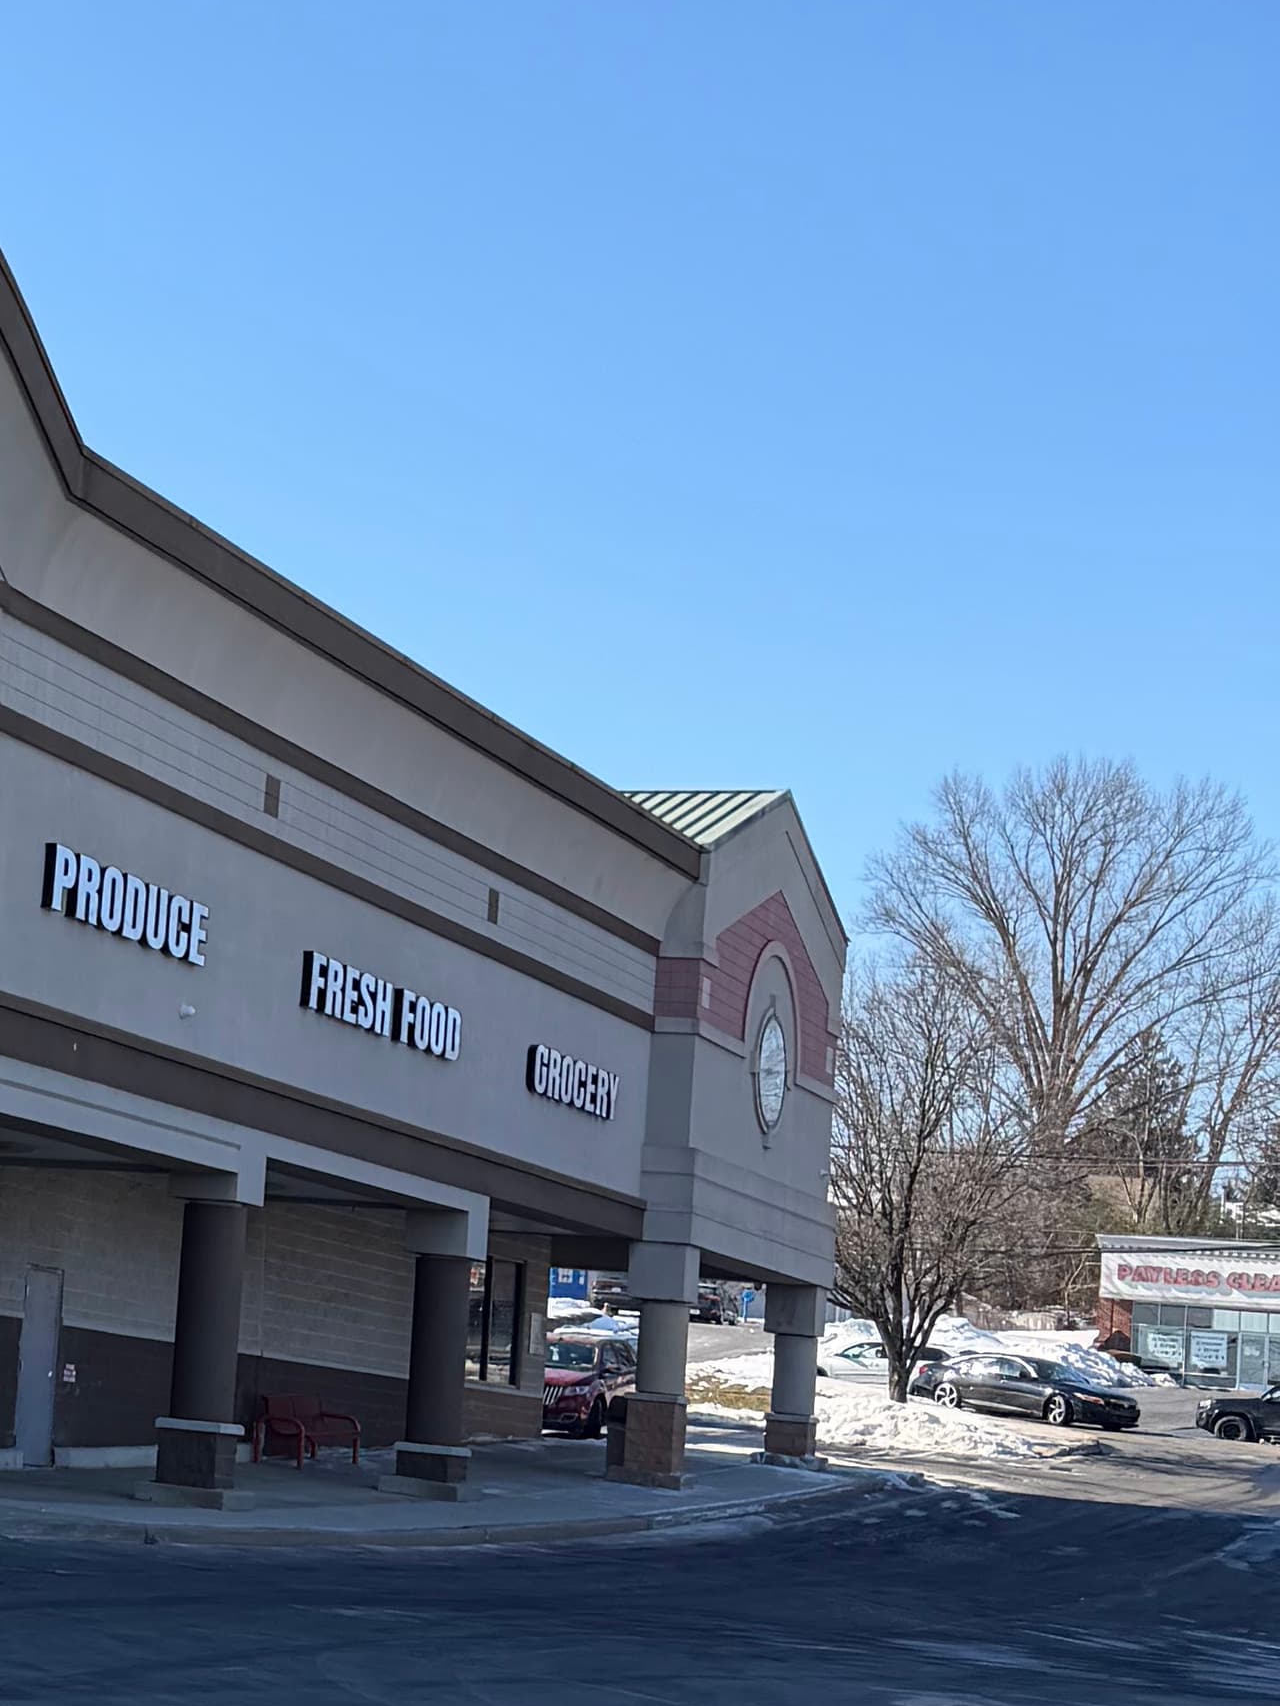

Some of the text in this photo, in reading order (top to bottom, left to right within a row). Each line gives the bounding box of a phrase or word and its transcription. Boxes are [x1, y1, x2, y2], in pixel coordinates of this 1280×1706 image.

[41, 842, 210, 967] PRODUCE
[299, 950, 463, 1061] FRESH FOOD
[526, 1044, 620, 1121] GROCERY
[1117, 1263, 1221, 1289] PAYLESS
